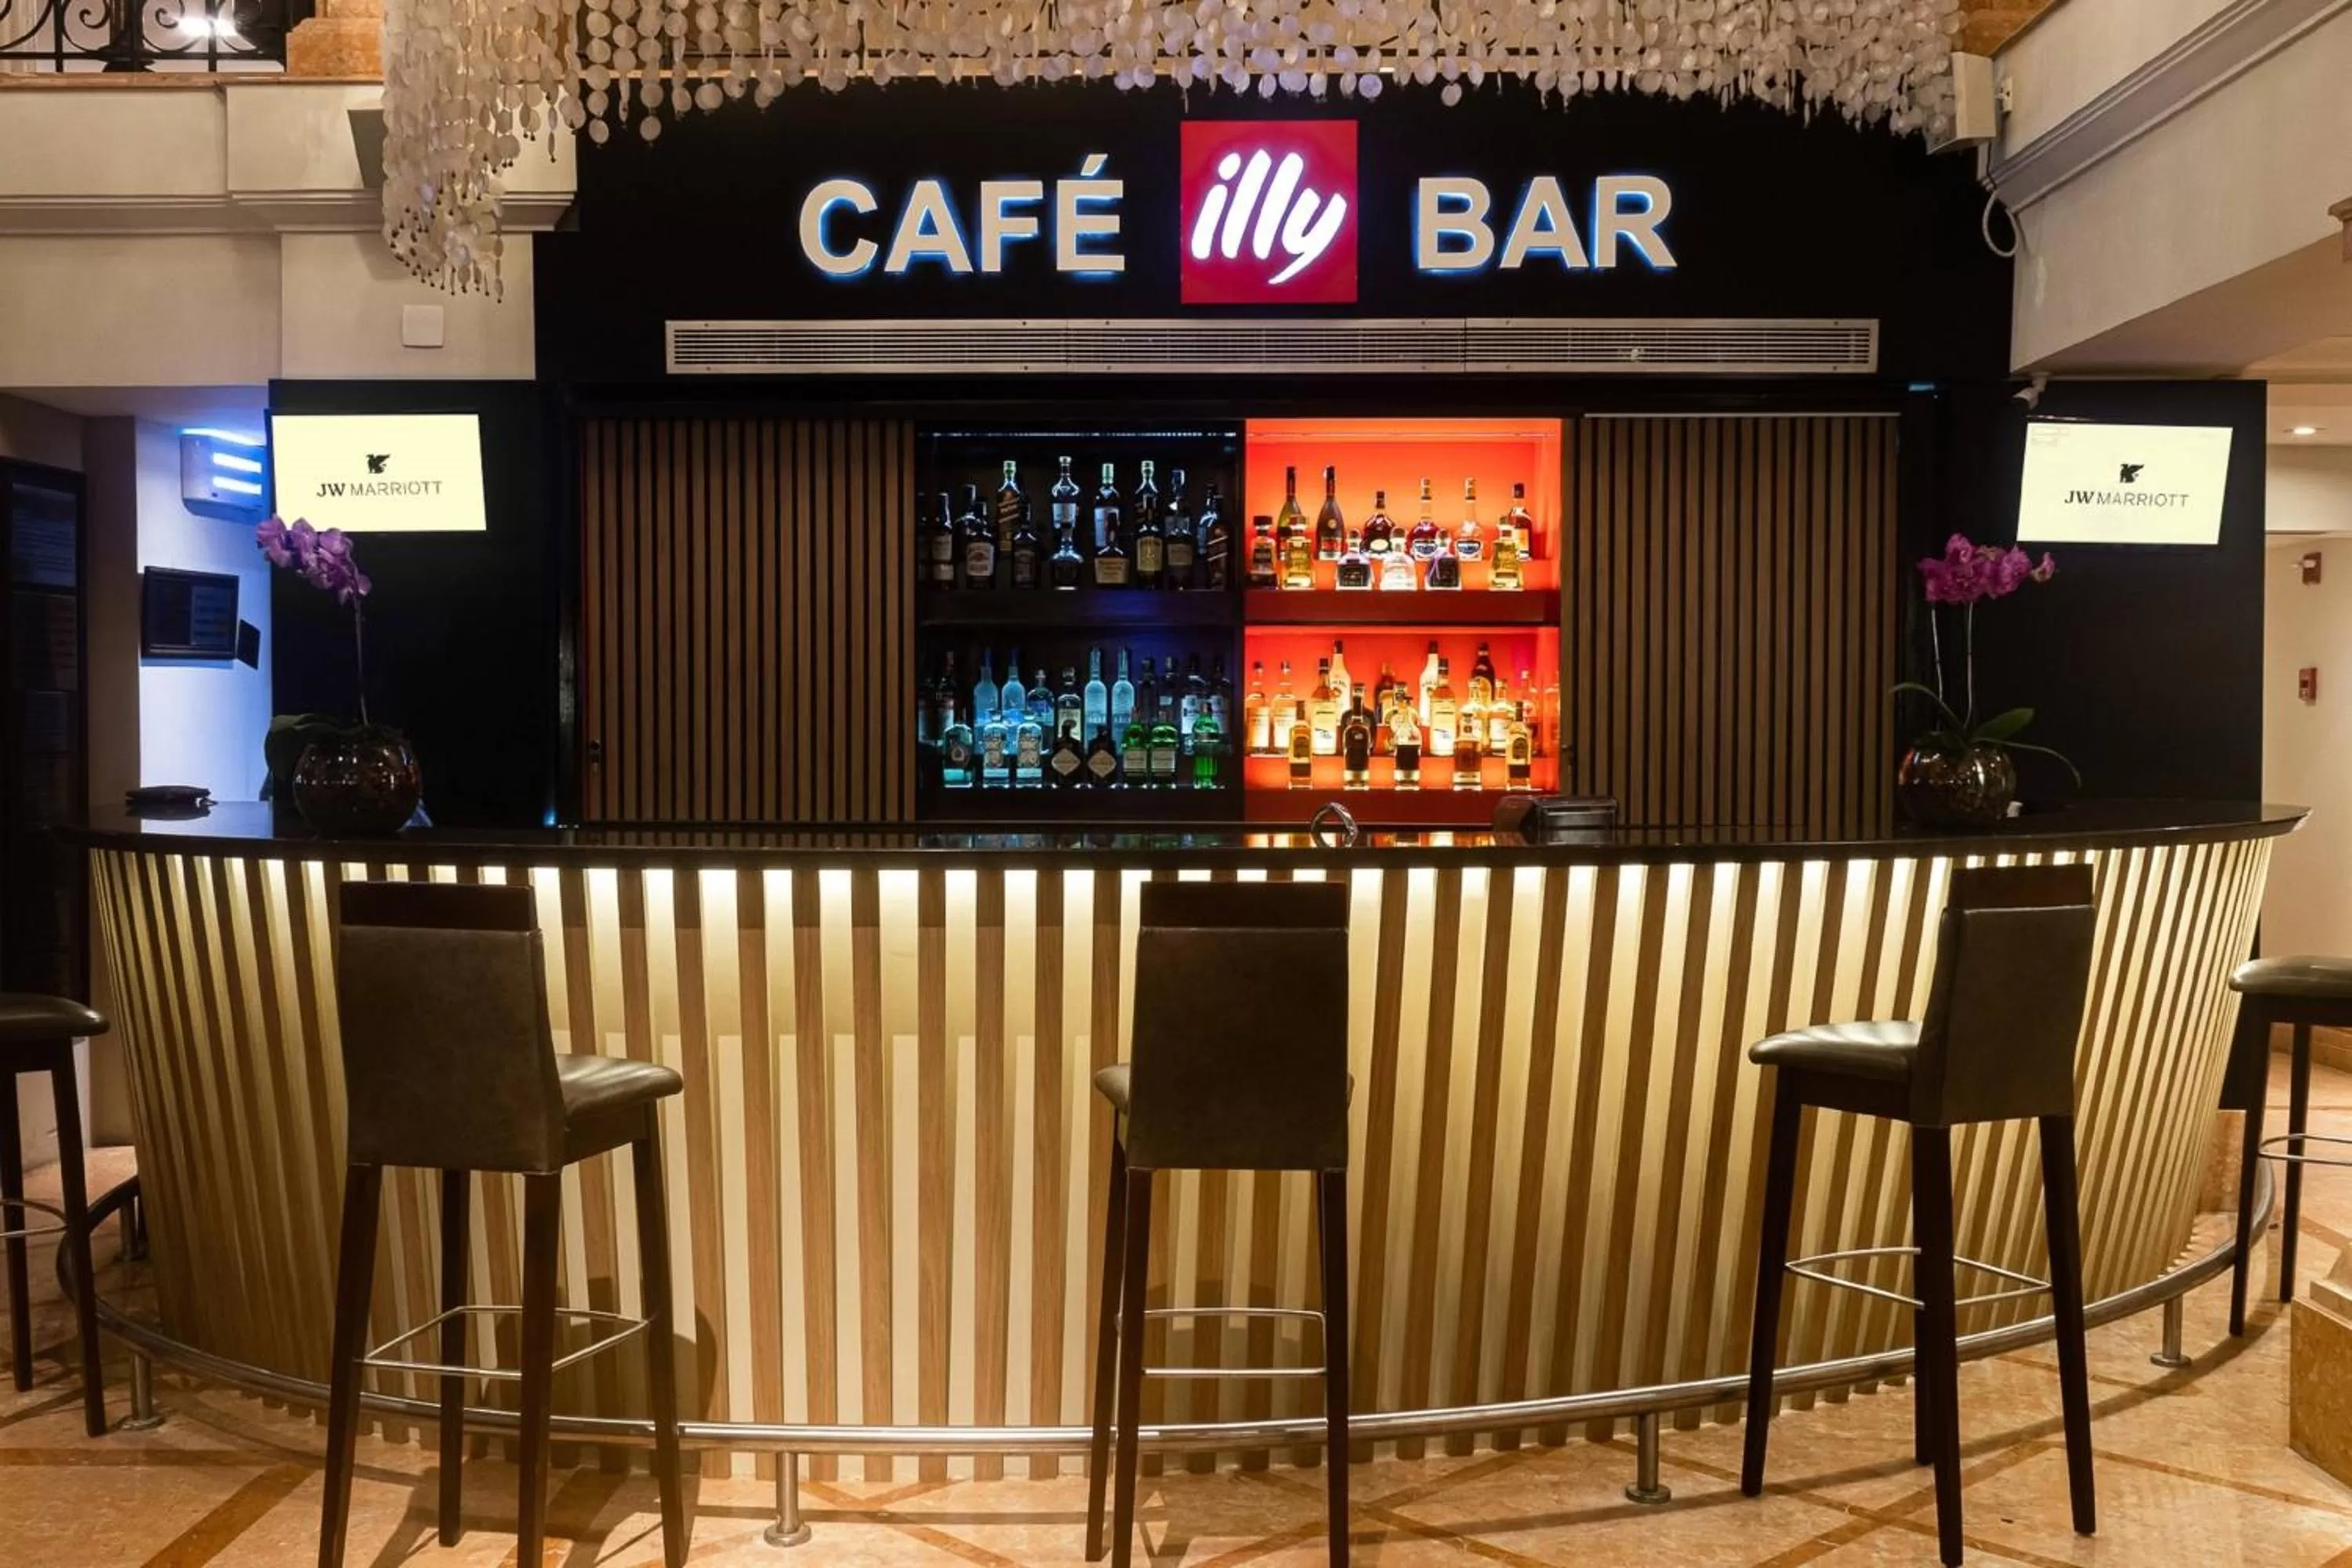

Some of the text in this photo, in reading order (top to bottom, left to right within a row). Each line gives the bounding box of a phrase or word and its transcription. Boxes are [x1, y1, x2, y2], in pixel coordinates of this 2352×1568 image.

[799, 149, 1678, 285] CAFÉ illy BAR
[316, 480, 443, 498] JW MARRIOTT
[2063, 490, 2190, 507] JW MARRIOTT
